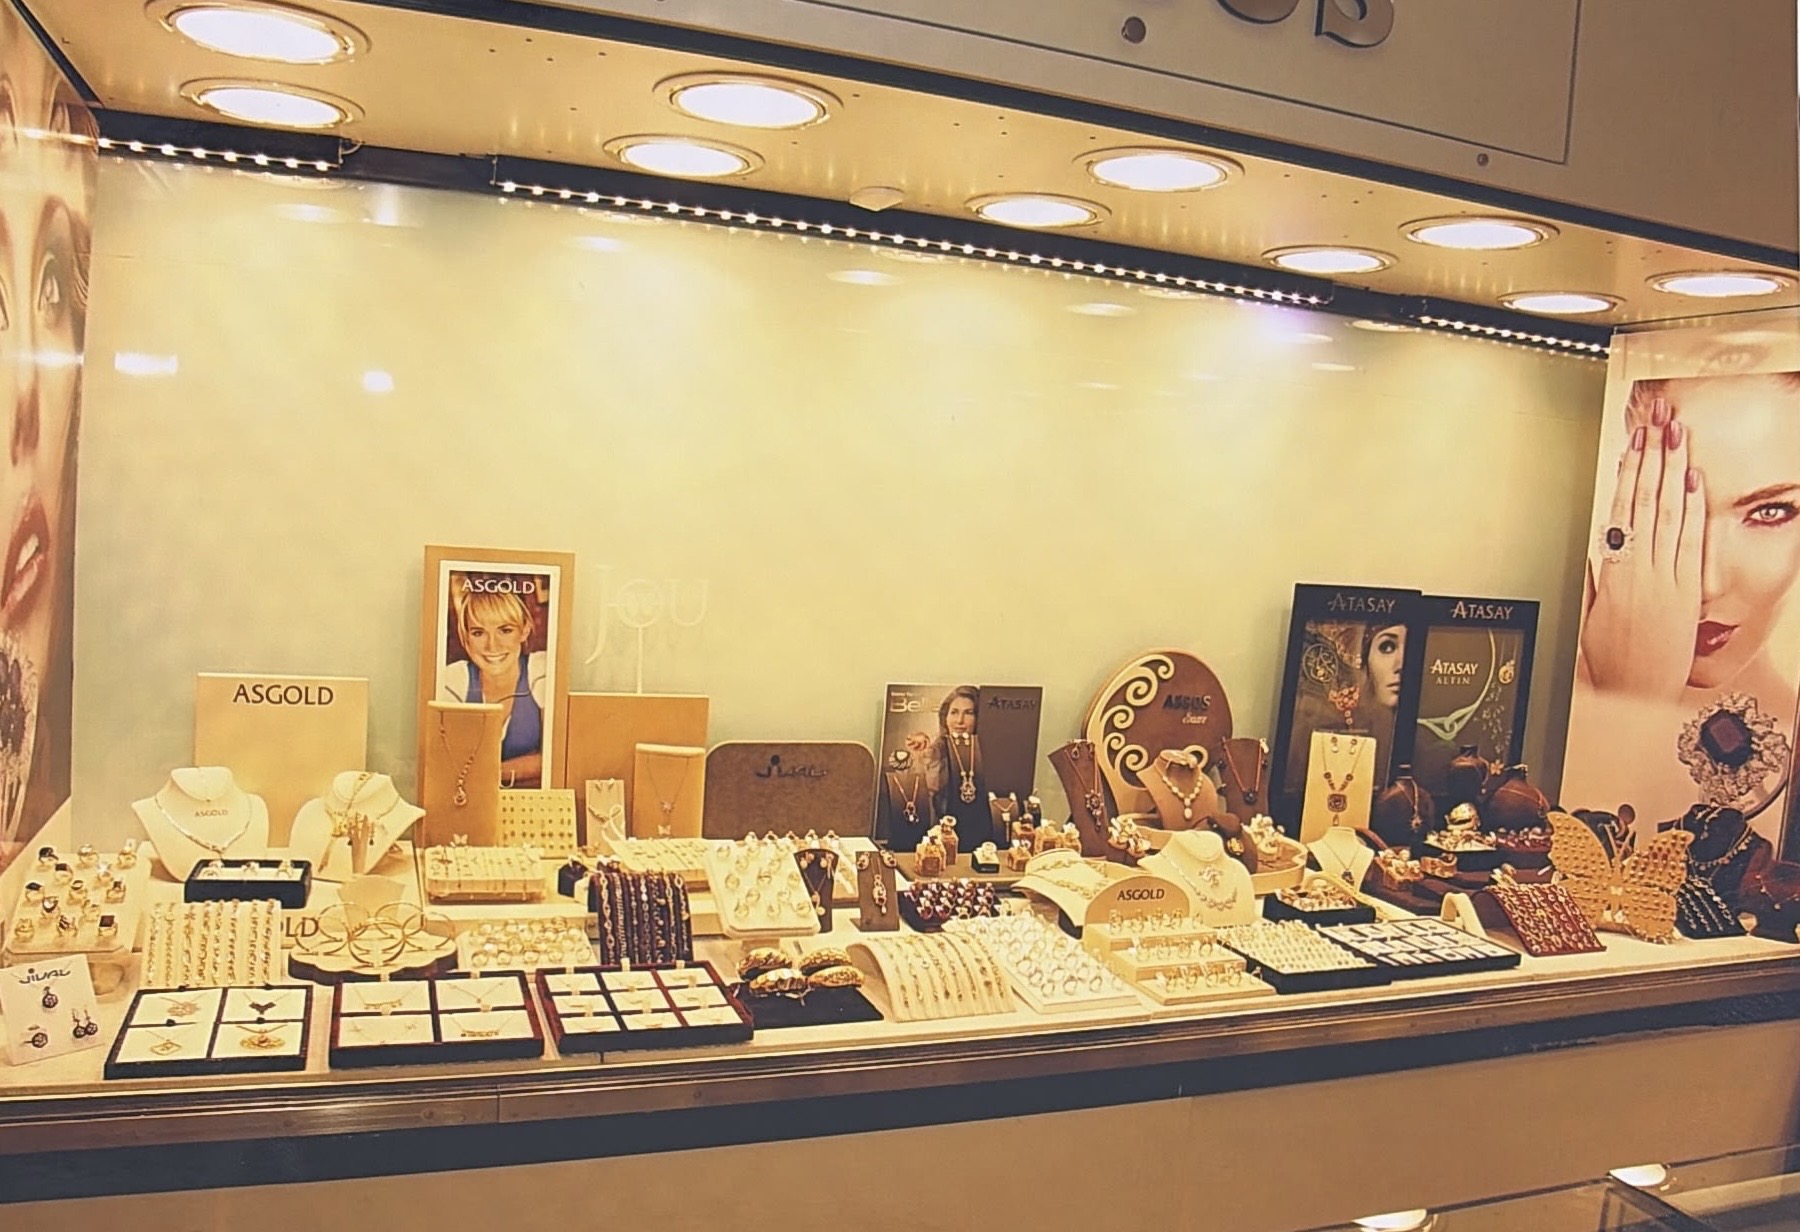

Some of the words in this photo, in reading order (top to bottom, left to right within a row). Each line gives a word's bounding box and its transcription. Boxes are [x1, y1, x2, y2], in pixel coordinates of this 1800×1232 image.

[461, 579, 535, 594] ASGOLD
[1328, 592, 1396, 613] ATASAY
[1450, 600, 1514, 620] ATASAY
[1430, 658, 1478, 675] ATASAY
[232, 683, 334, 706] ASGOLD
[1117, 888, 1165, 901] ASGOLD
